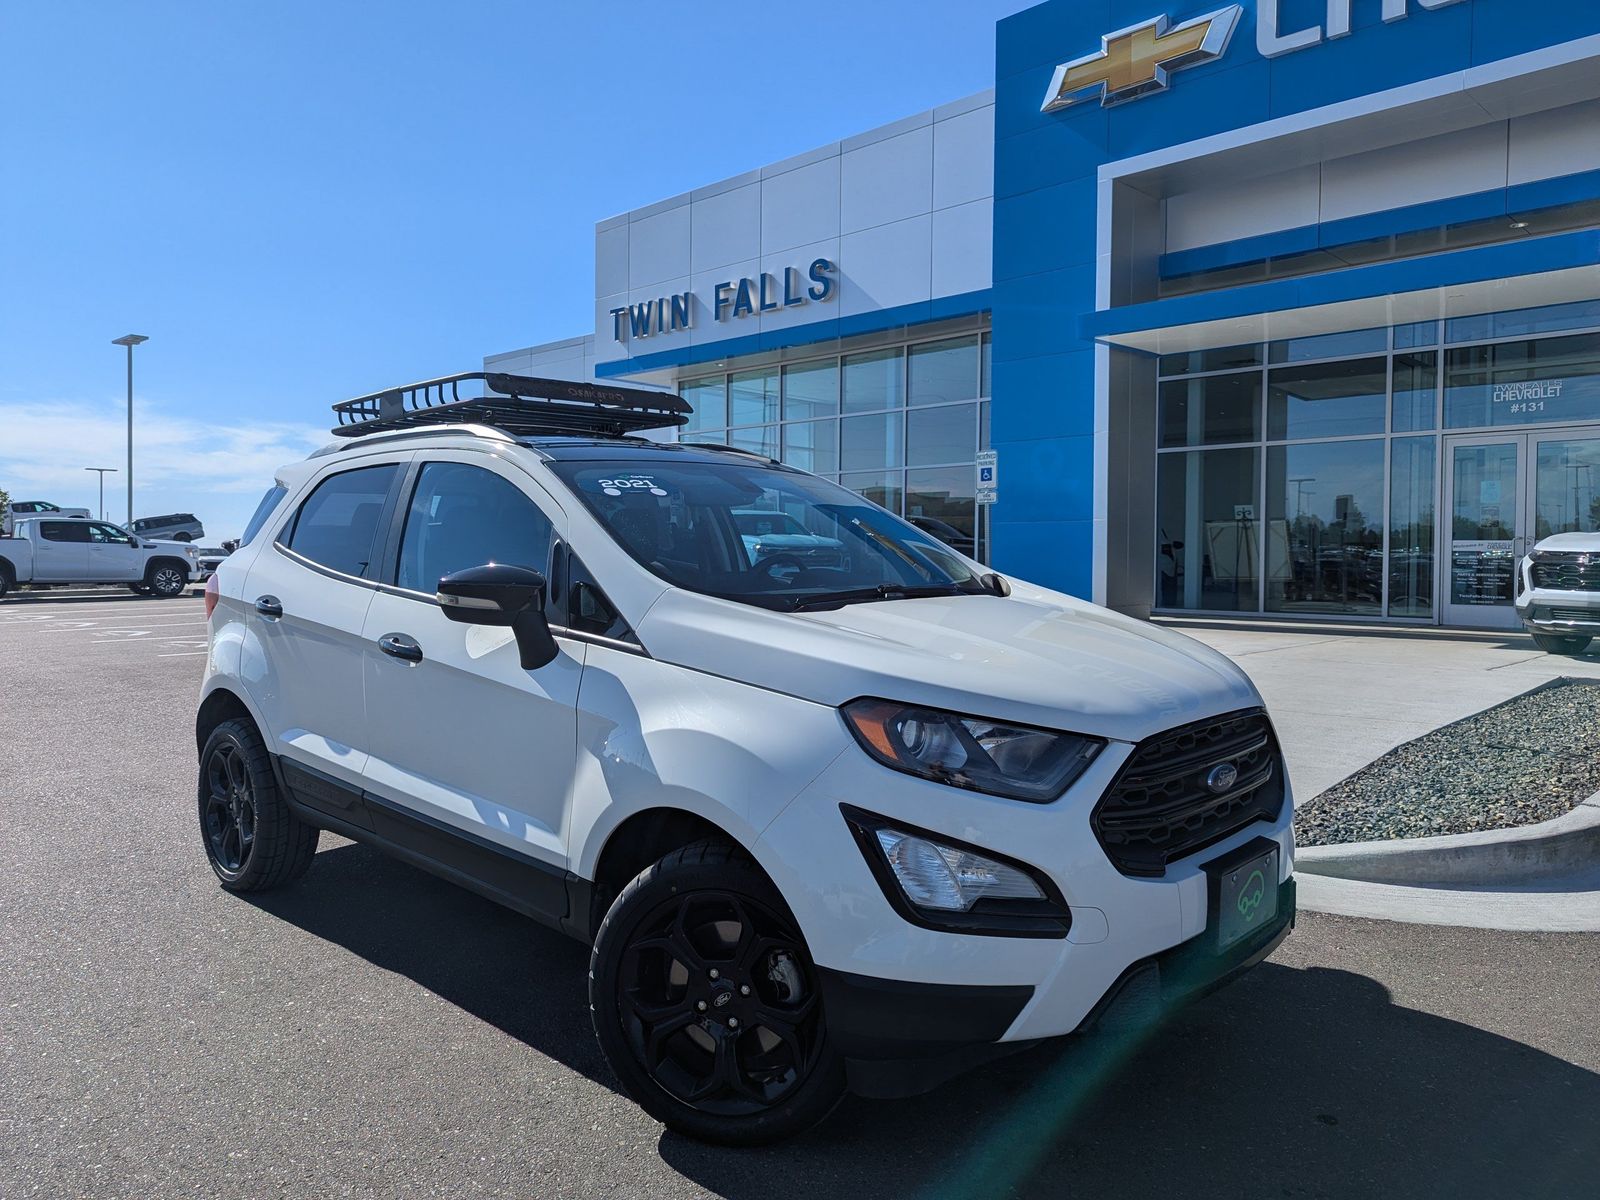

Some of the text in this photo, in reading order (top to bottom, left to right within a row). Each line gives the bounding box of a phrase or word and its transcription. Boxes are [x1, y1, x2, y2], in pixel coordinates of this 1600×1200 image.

[610, 258, 834, 343] TWIN FALLS
[1493, 386, 1562, 402] CHEVROLET
[1510, 401, 1545, 413] #131
[598, 479, 658, 488] 2021
